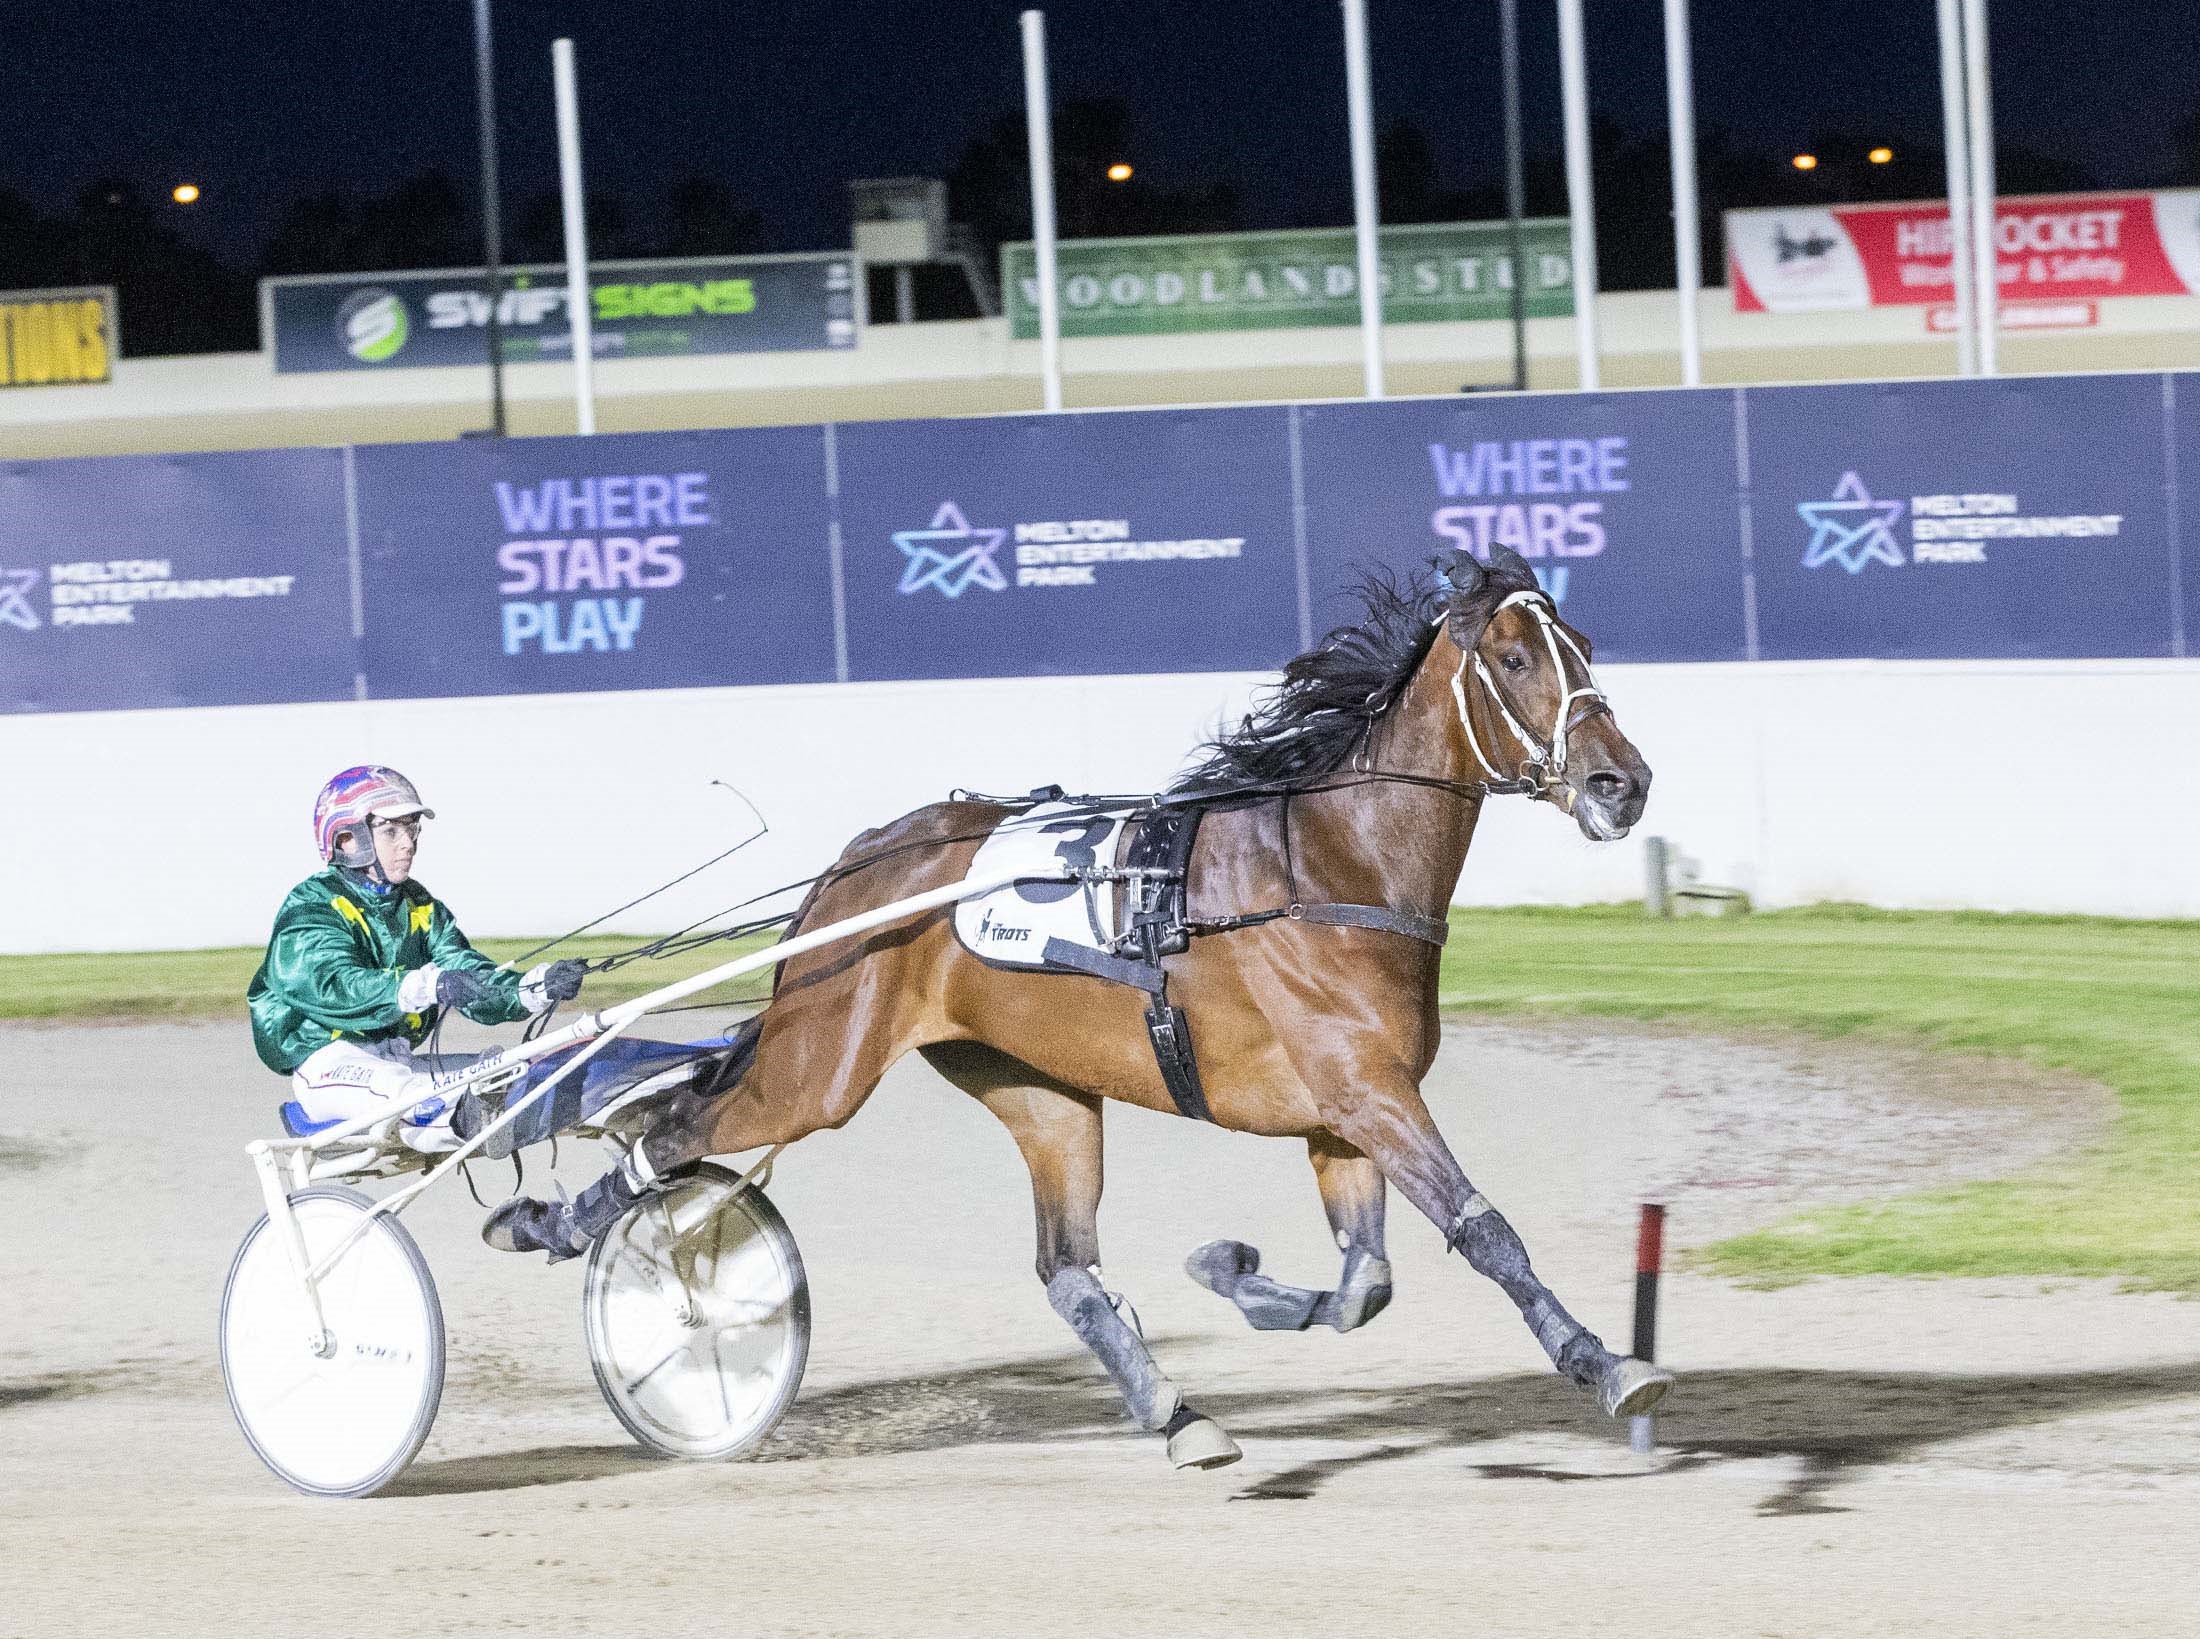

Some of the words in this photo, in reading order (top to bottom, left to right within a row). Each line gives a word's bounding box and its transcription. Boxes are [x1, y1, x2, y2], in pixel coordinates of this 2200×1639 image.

[1992, 210, 2124, 254] OCKET
[593, 278, 758, 320] SIGNS
[1429, 436, 1632, 497] WHERE
[494, 472, 713, 533] WHERE
[1911, 494, 2018, 515] MELTON
[1014, 520, 1131, 543] MELTON
[1432, 502, 1607, 560] STARS
[497, 534, 685, 595] STARS
[1015, 538, 1246, 566] ENTERTAINMENT
[50, 559, 172, 584] MELTON
[1016, 565, 1097, 587] PARK
[51, 575, 295, 606] ENTERTAINMENT
[52, 602, 135, 626] PARK
[502, 597, 646, 656] PLAY
[991, 927, 1032, 942] TROTS
